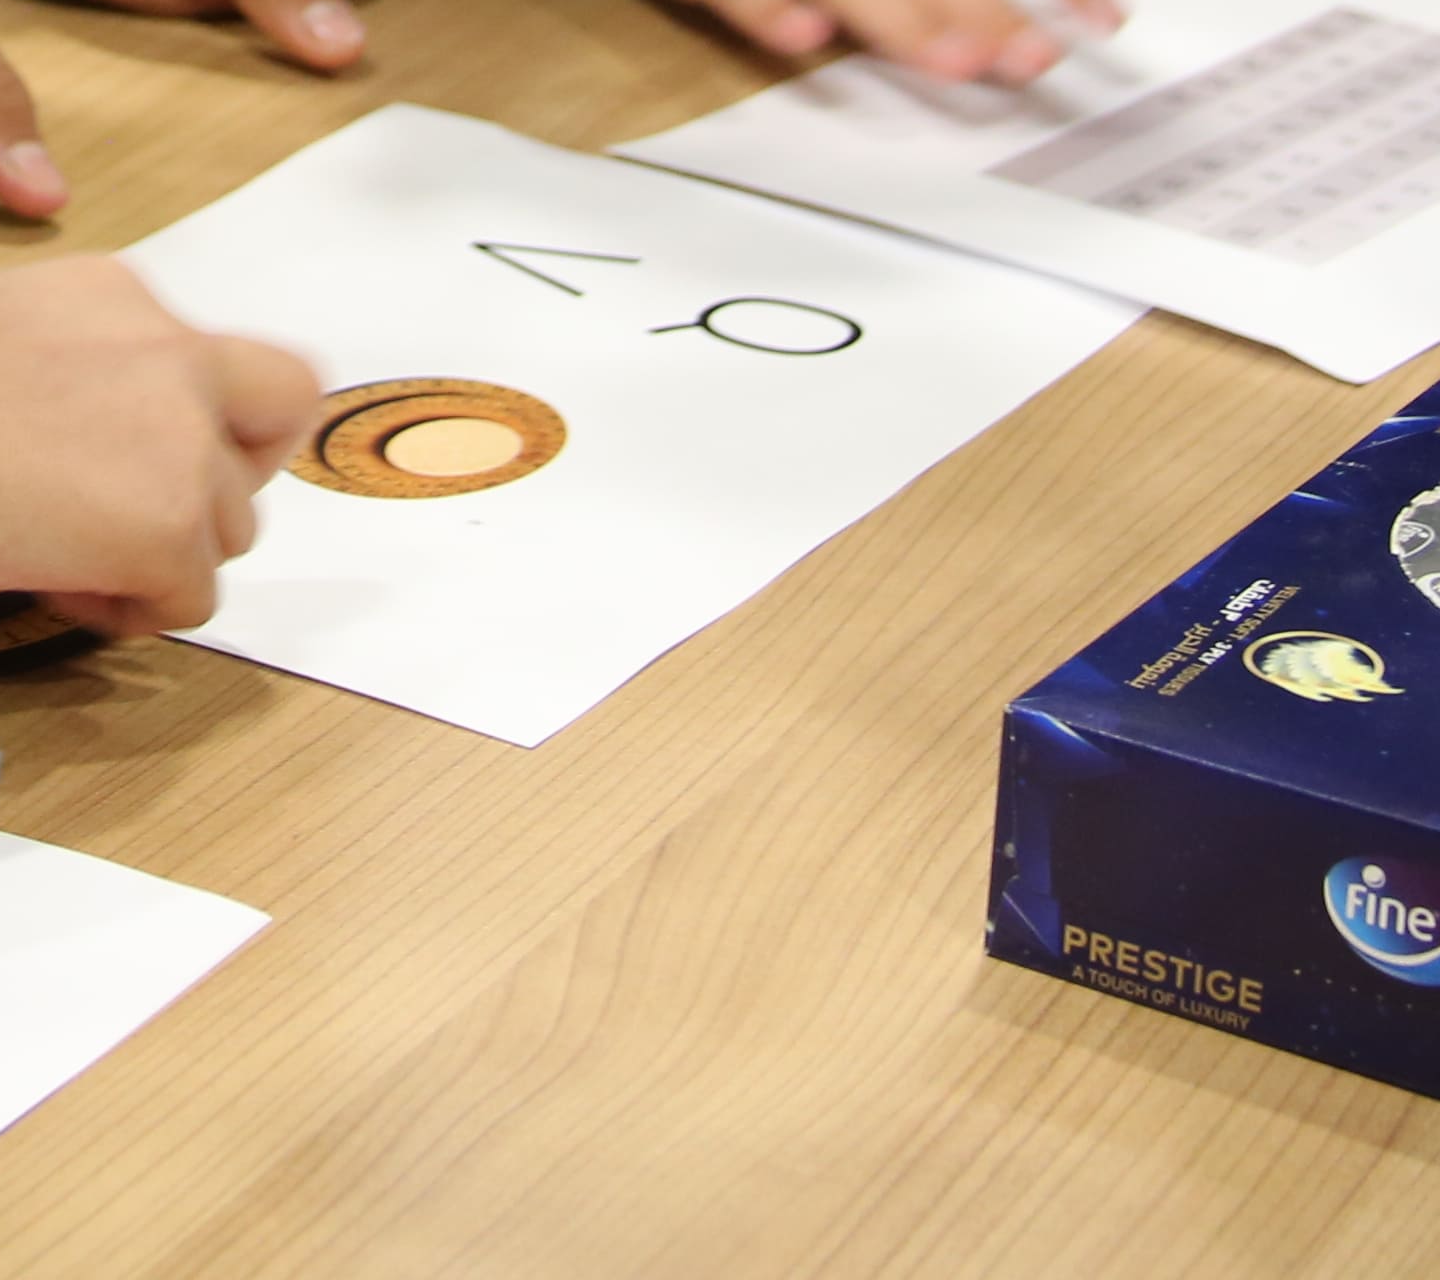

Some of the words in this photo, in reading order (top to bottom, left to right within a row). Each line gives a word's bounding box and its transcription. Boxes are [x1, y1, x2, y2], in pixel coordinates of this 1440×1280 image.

[1063, 924, 1264, 1013] PRESTIGE
[1072, 964, 1084, 980] A
[1089, 968, 1148, 1000] TOUCH
[1152, 988, 1176, 1006] OF
[1180, 997, 1251, 1031] LUXURY
